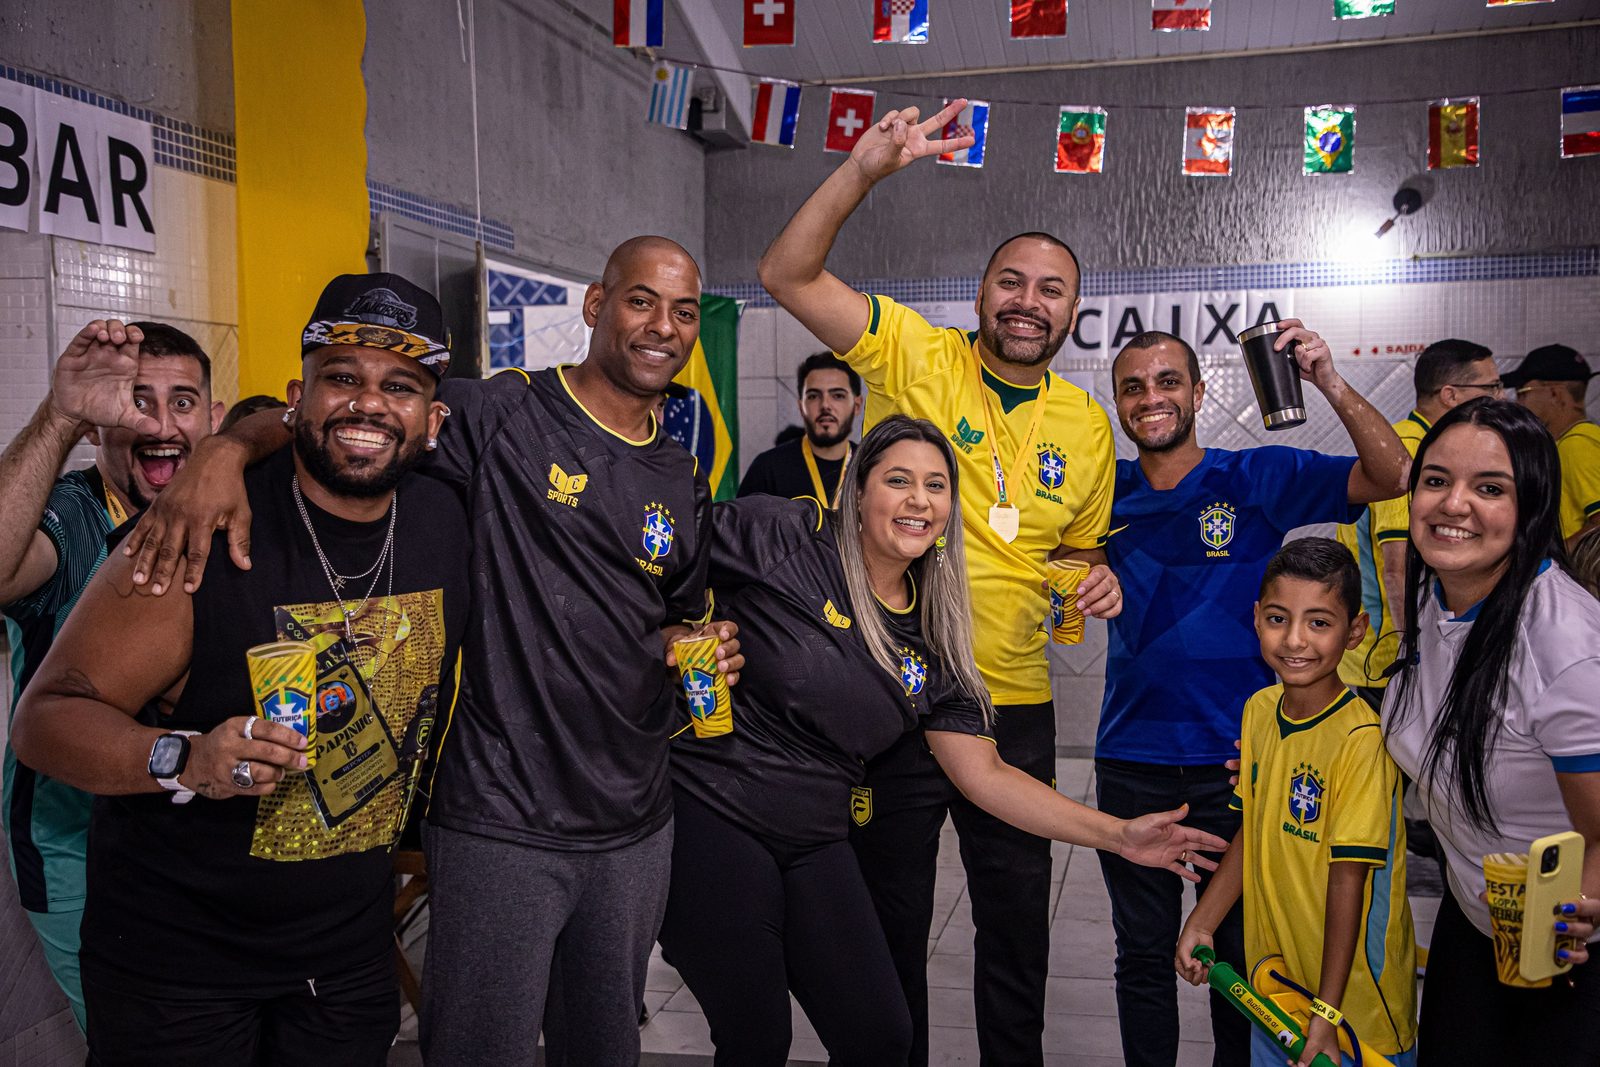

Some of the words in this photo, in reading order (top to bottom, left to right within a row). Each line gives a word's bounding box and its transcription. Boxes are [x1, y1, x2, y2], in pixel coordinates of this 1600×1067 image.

[0, 106, 156, 234] BAR
[951, 433, 973, 454] SPORTS
[547, 488, 579, 508] SPORTS
[1036, 488, 1064, 505] BRASIL
[635, 557, 664, 577] RASIL
[1282, 821, 1320, 843] BRASIL
[1493, 897, 1518, 909] COPA
[1246, 997, 1266, 1016] Buzina
[1263, 1014, 1272, 1023] de
[1271, 1021, 1279, 1029] ar
[1312, 1001, 1327, 1014] RIÇA
